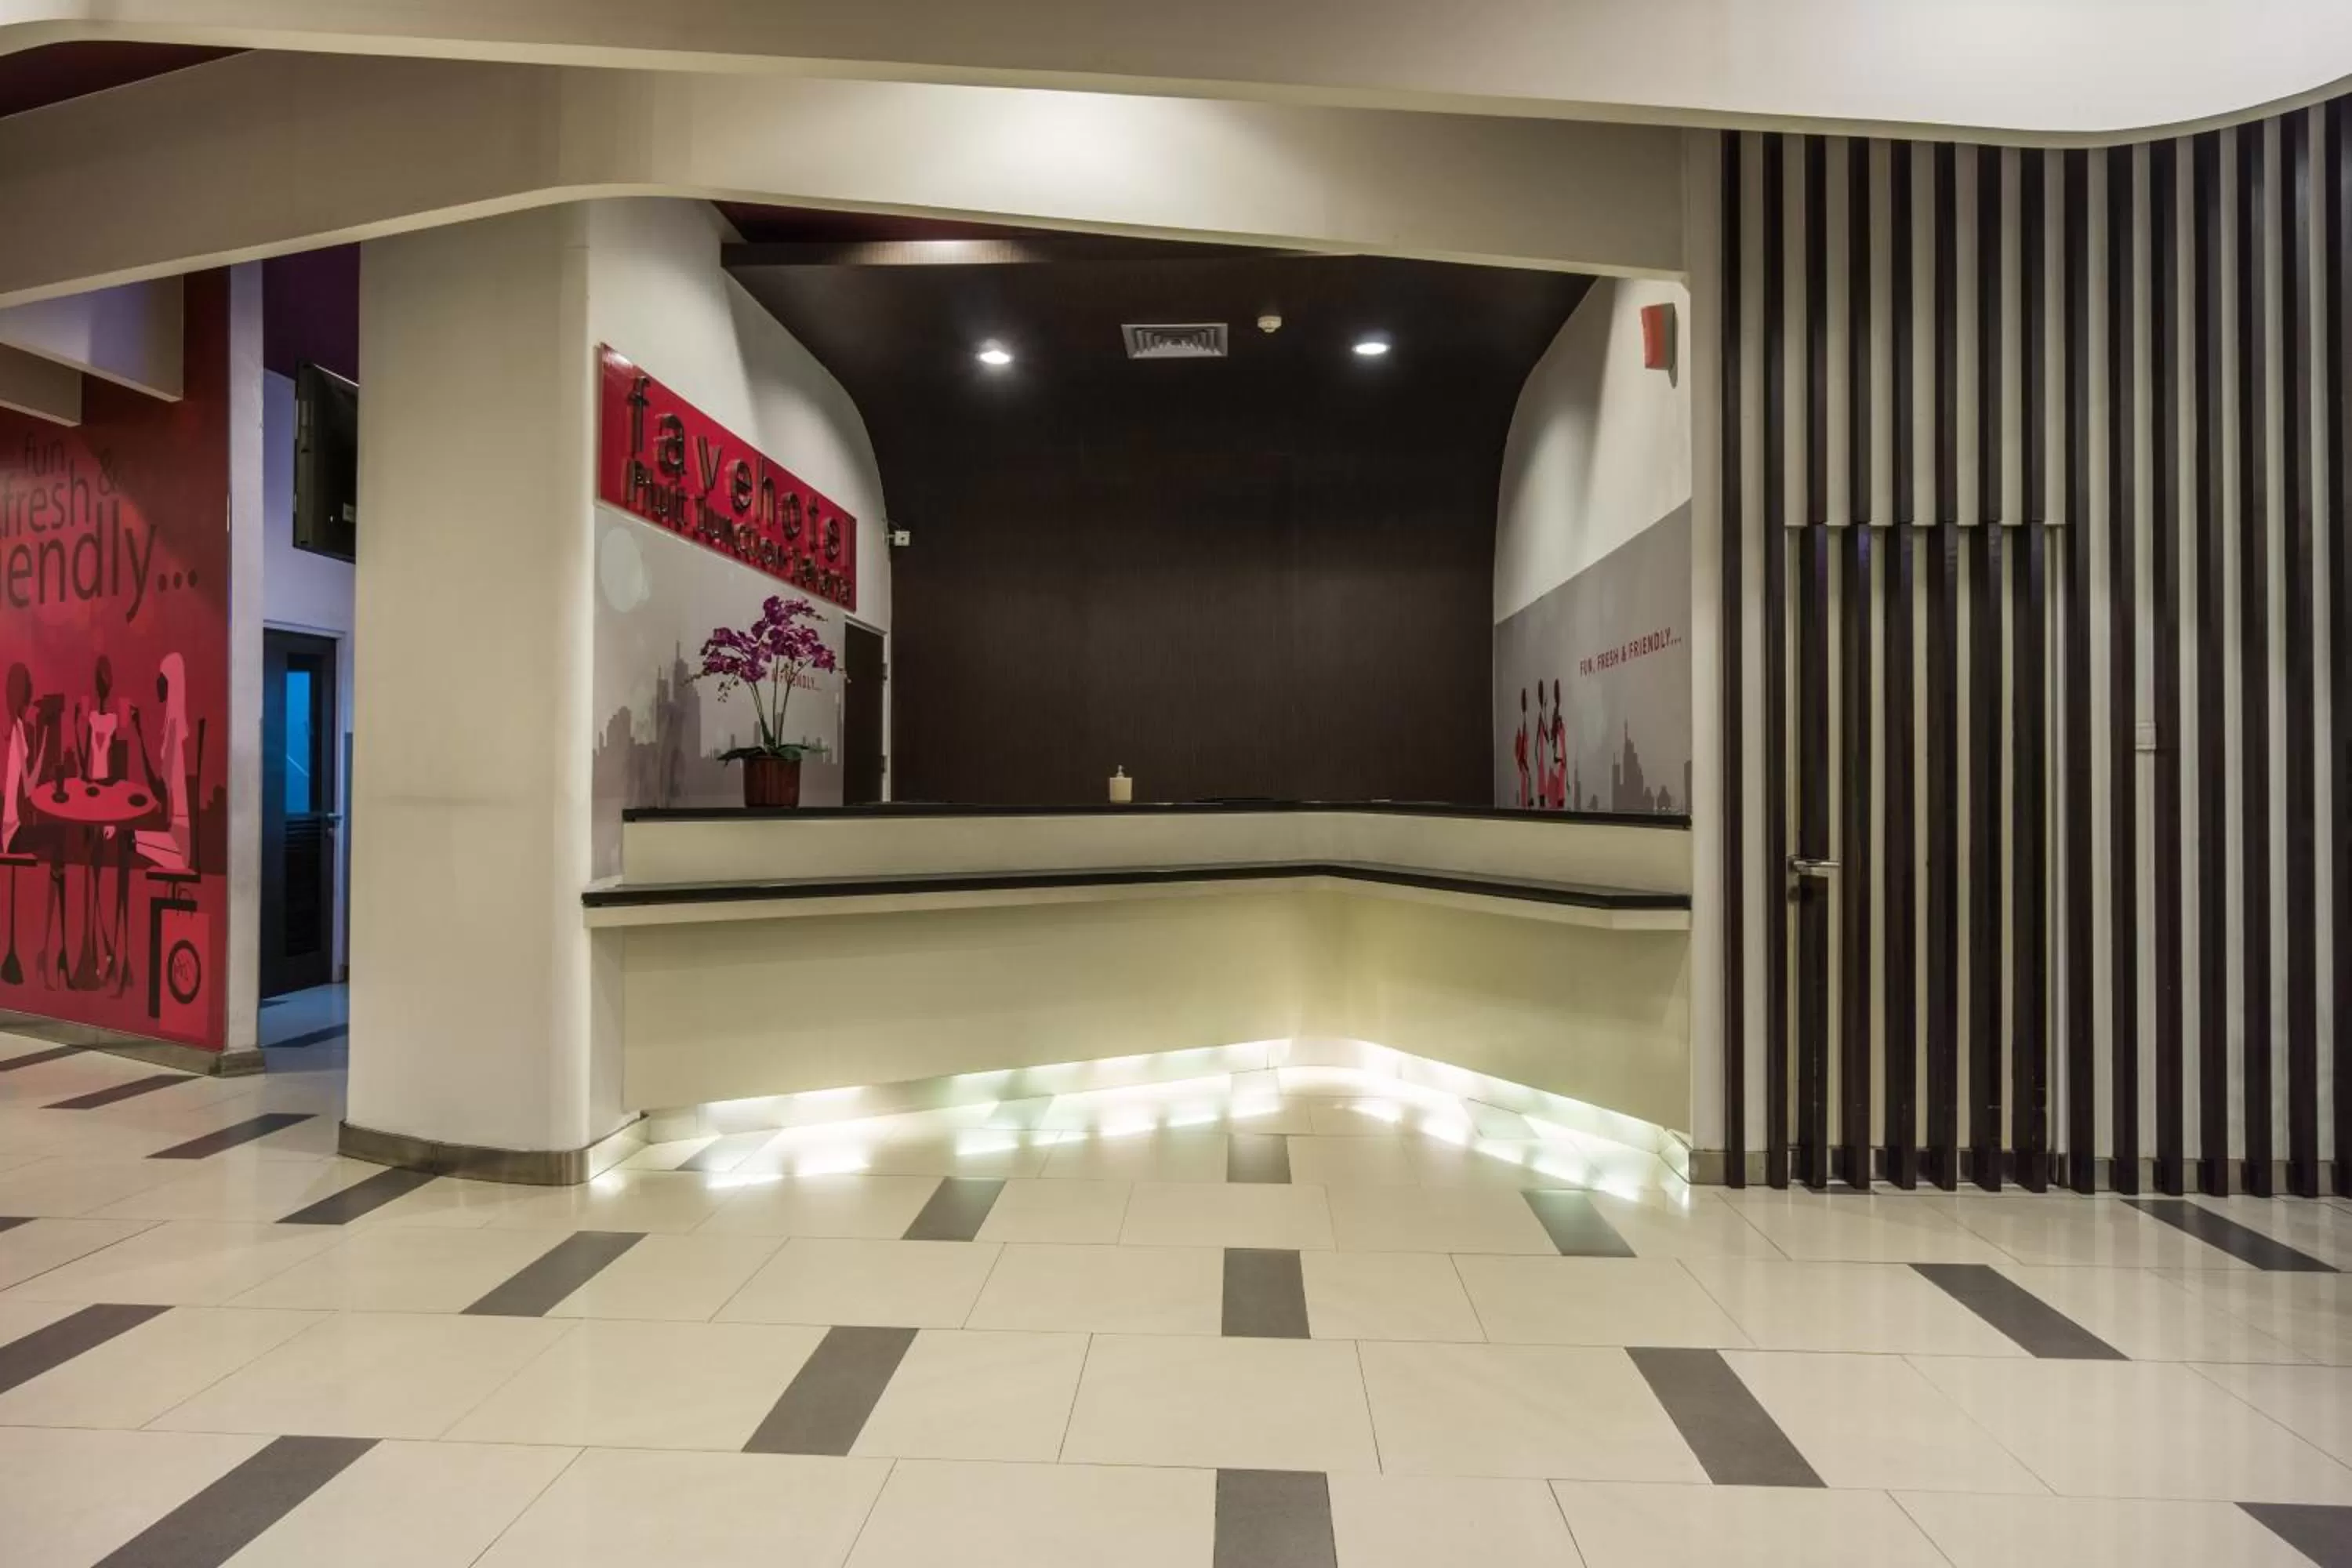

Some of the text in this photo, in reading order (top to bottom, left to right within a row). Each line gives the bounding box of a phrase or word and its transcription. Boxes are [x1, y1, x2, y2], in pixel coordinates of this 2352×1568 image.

[24, 432, 65, 477] fun
[625, 375, 855, 567] favehotel
[1, 458, 90, 539] fresh
[6, 499, 198, 625] endly...
[1597, 649, 1620, 671] FRESH
[1621, 645, 1628, 663] &
